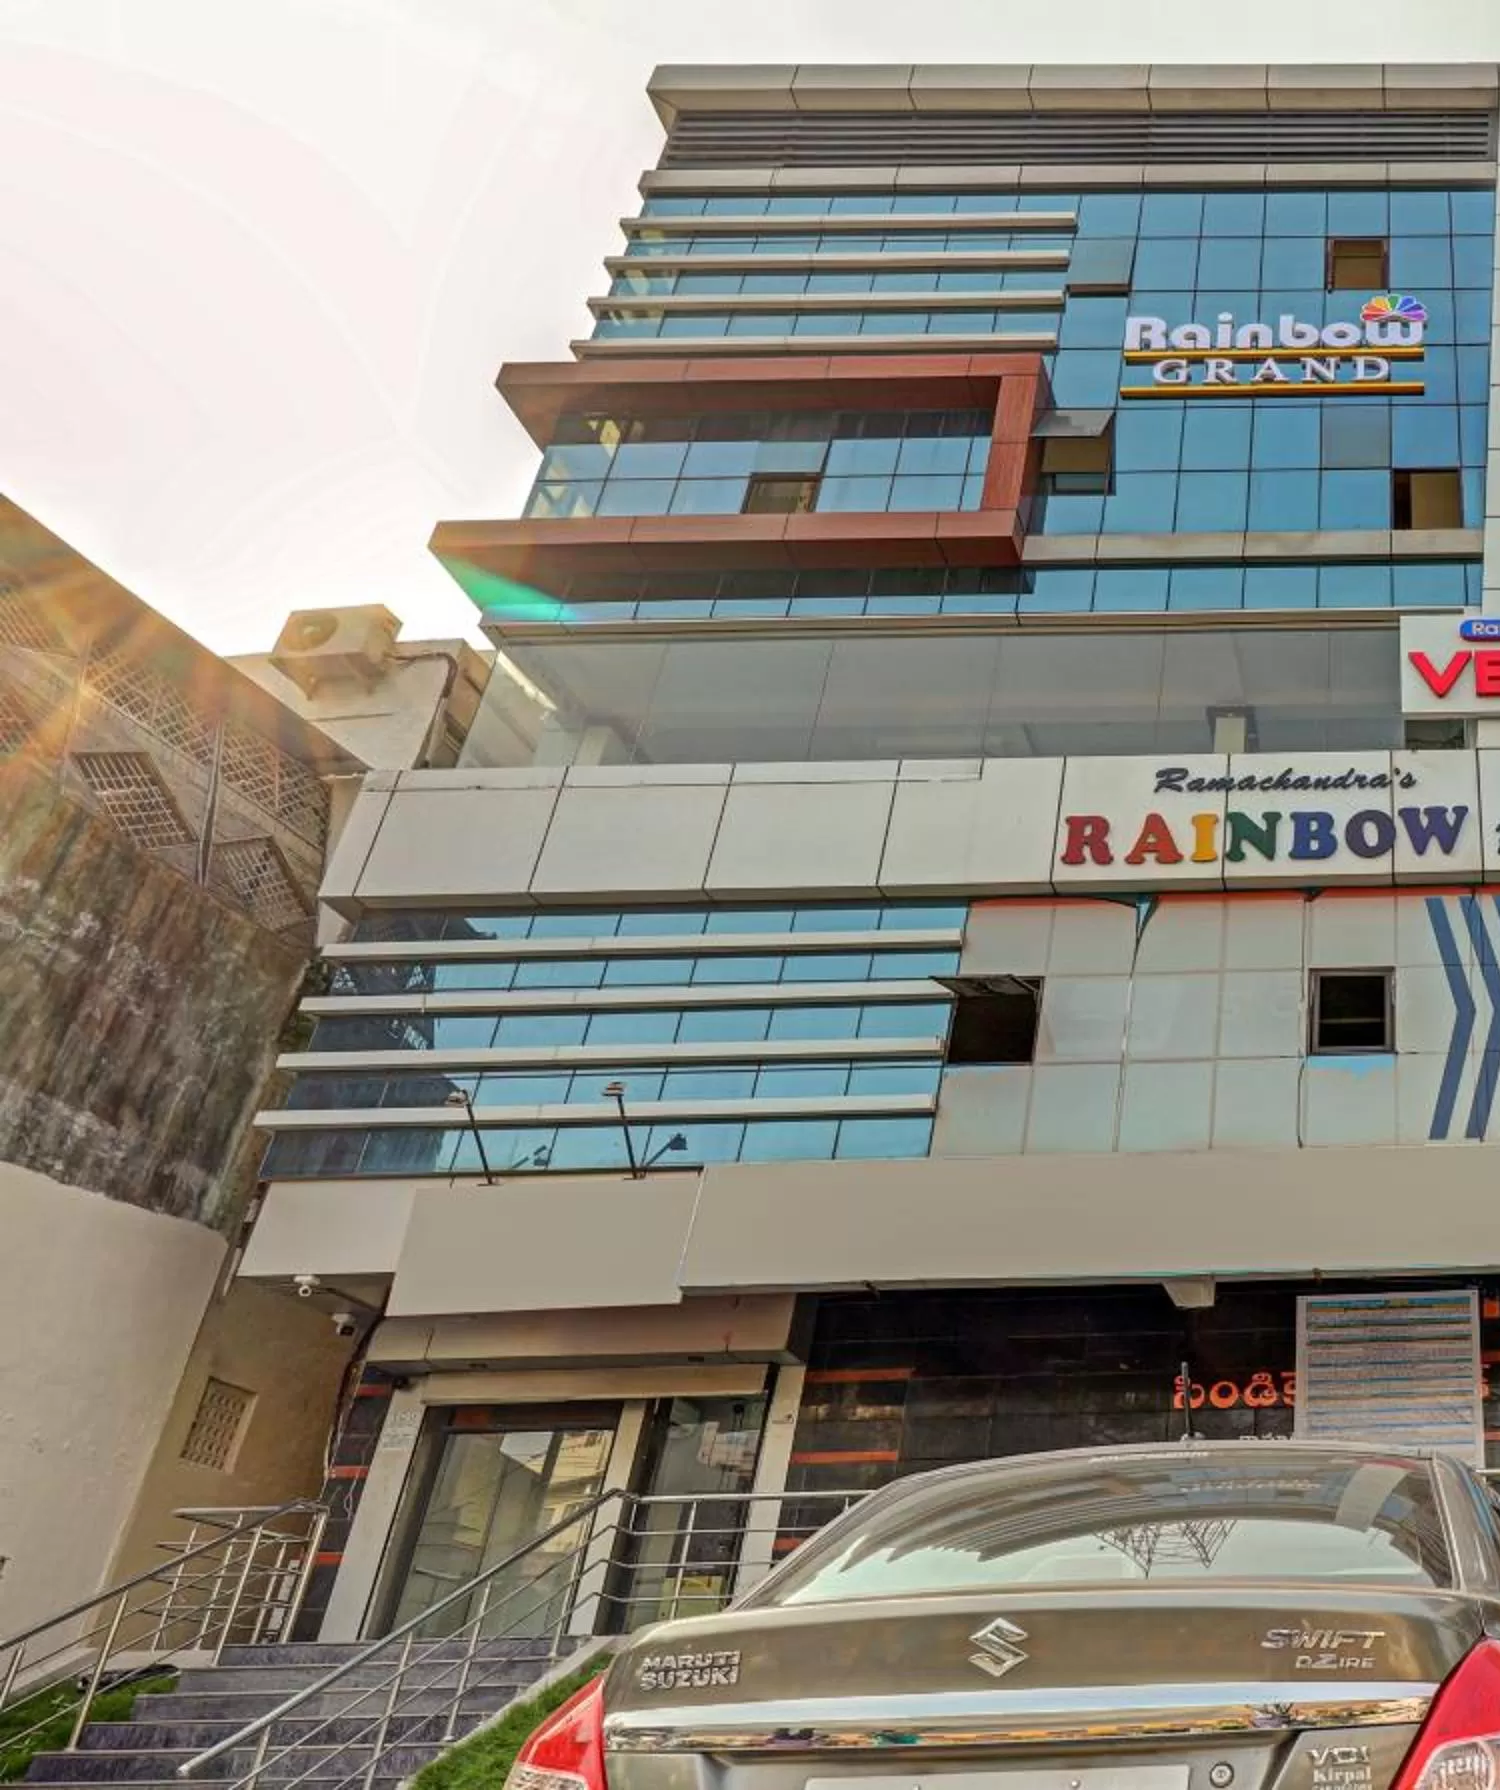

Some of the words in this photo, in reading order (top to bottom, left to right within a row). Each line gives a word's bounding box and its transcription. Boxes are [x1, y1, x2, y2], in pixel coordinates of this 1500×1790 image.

[1125, 312, 1425, 349] Rainbow
[1152, 355, 1390, 386] GRAND
[1153, 766, 1417, 794] Ramachandra's
[1060, 805, 1470, 865] RAINBOW
[1260, 1629, 1386, 1649] SWIFT
[640, 1651, 741, 1672] MARUTI
[640, 1666, 739, 1691] SUZUKI
[1313, 1766, 1371, 1785] Kirpal
